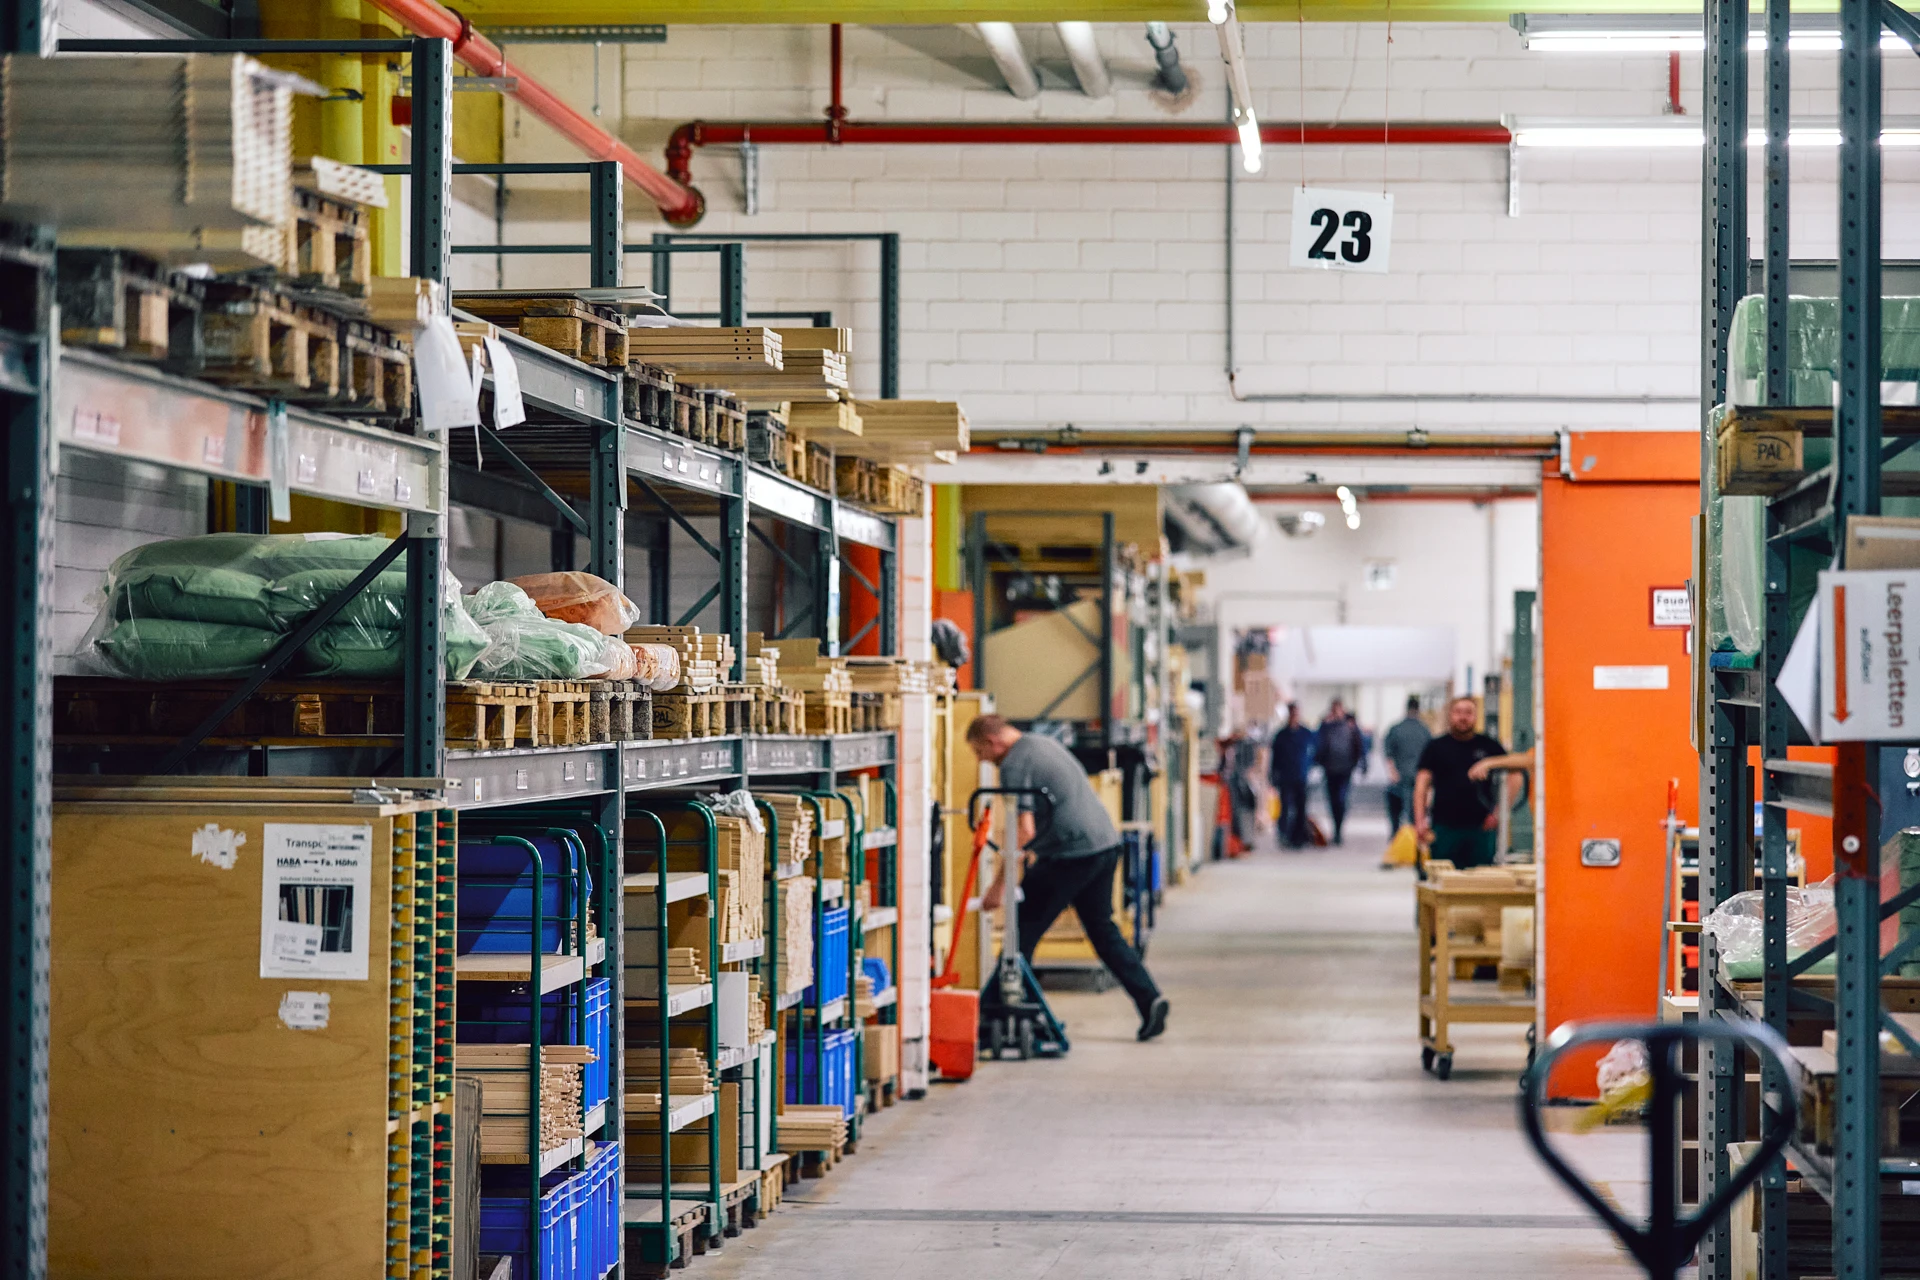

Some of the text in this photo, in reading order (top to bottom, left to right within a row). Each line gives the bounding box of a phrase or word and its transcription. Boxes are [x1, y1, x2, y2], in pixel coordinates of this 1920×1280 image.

[1308, 208, 1372, 263] 23
[1755, 443, 1785, 461] PAL
[1883, 582, 1908, 728] Leerpaletten
[653, 710, 673, 723] PAL
[276, 858, 301, 867] HABA
